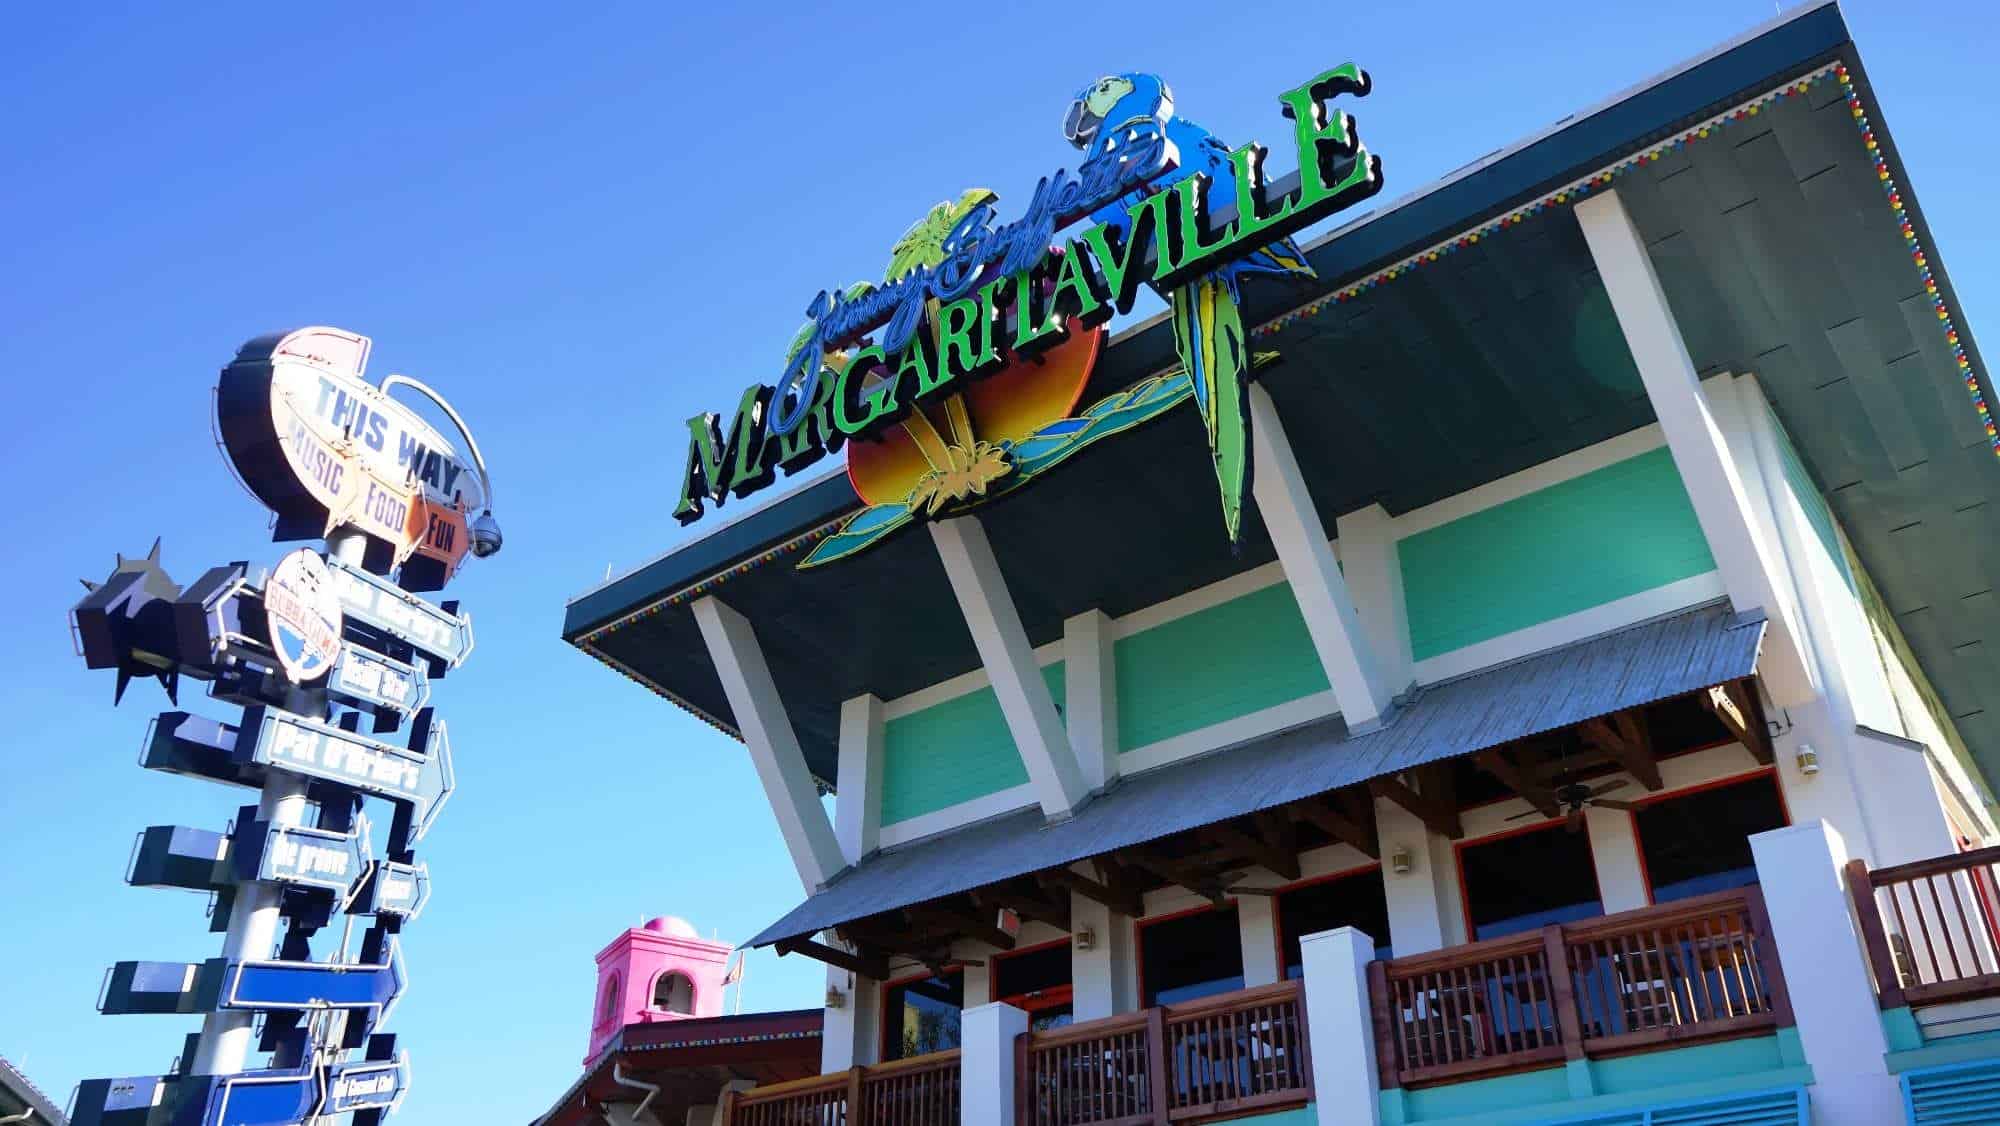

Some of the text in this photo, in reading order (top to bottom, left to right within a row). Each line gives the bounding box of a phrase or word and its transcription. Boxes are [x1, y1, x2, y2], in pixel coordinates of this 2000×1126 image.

[672, 62, 1381, 523] MARGARITAVILLE
[766, 265, 929, 435] Jimmy
[314, 375, 388, 452] THIS
[288, 417, 344, 496] MUSIC
[364, 483, 408, 533] FOOD
[427, 512, 456, 553] FUN
[273, 719, 319, 763] Pat
